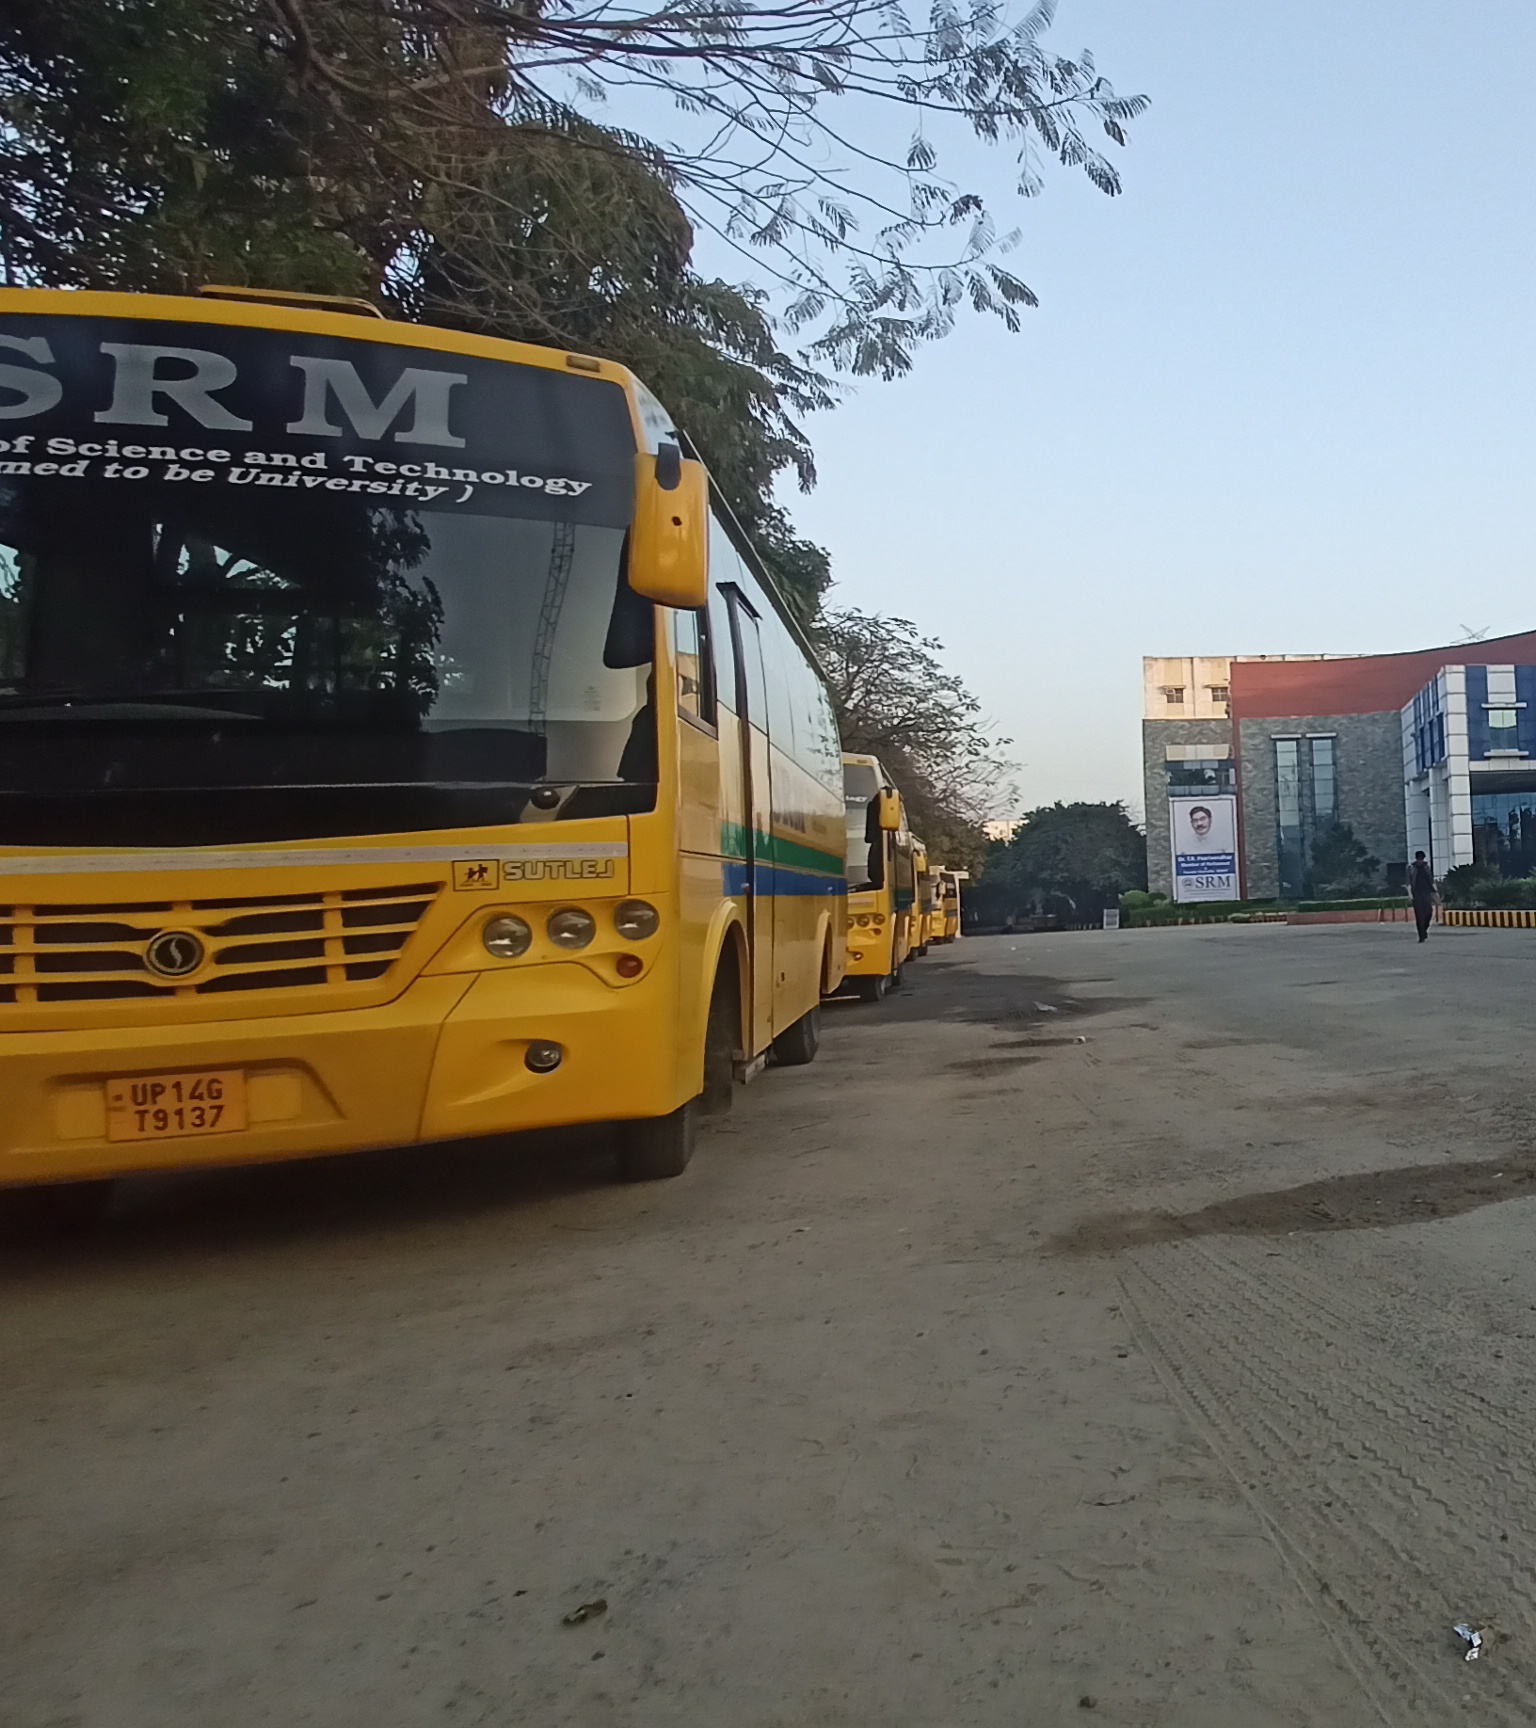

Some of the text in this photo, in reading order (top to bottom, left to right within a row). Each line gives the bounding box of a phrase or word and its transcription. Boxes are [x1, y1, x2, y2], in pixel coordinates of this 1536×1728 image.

[46, 437, 231, 463] Science
[243, 451, 328, 470] and
[342, 455, 593, 497] Technology
[103, 462, 150, 479] to
[163, 464, 216, 483] be
[227, 467, 449, 502] University
[503, 859, 615, 881] SUTLEJ
[1195, 875, 1231, 889] SRM
[130, 1078, 223, 1106] UP14G
[134, 1104, 225, 1132] T9137
